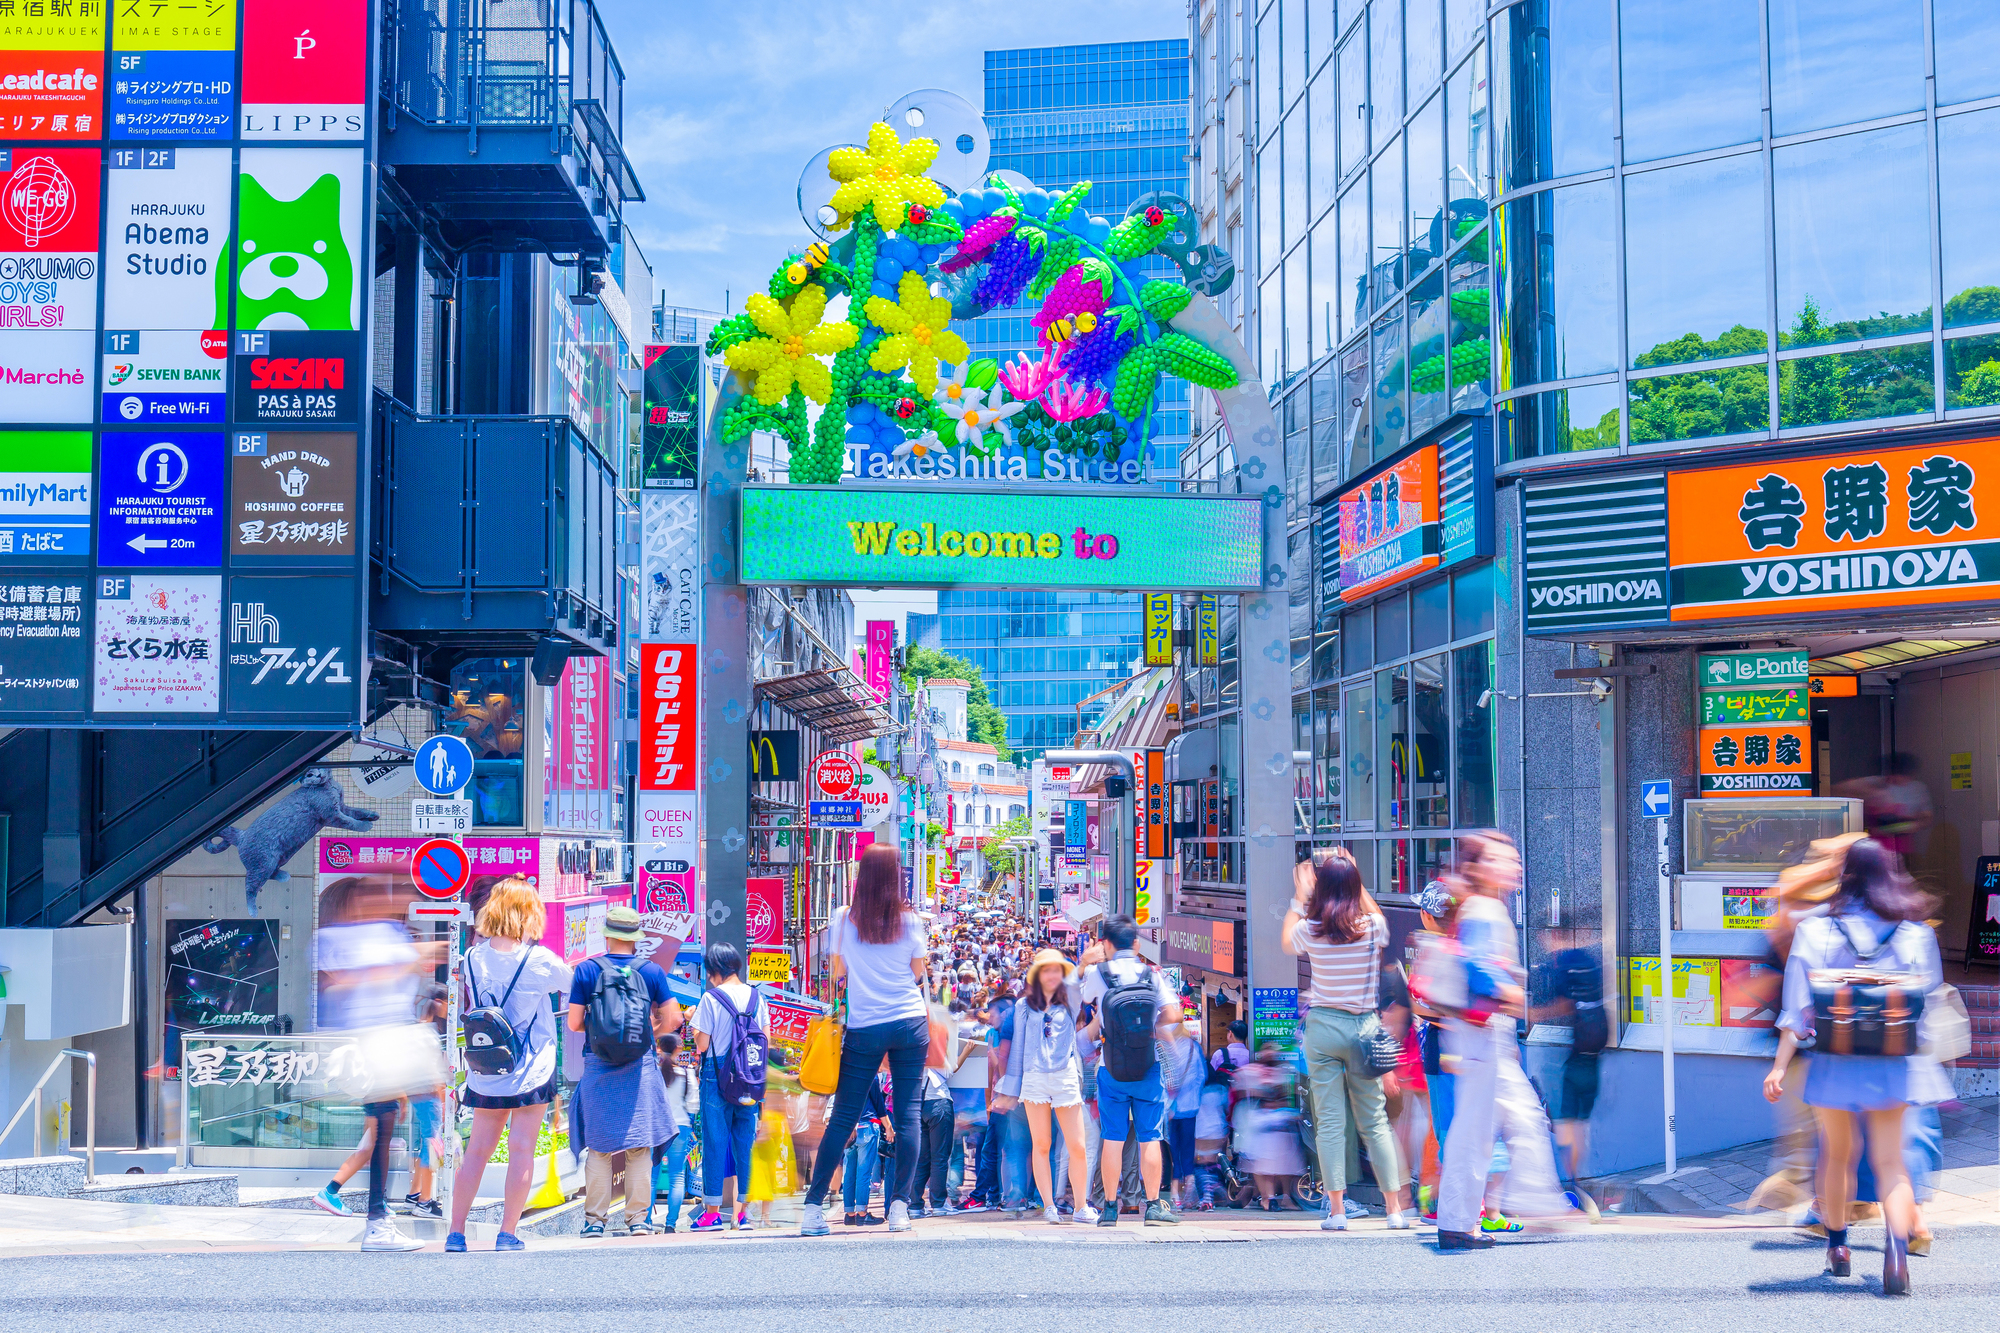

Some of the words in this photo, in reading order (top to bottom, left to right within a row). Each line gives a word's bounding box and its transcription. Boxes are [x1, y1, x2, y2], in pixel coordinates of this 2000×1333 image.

[121, 28, 162, 36] IMAE
[172, 28, 223, 36] STAGE
[120, 57, 141, 70] 5F
[126, 98, 159, 106] Risingpro
[244, 115, 362, 132] LIPPS
[128, 127, 150, 135] Rising
[152, 127, 189, 136] production
[116, 151, 134, 166] 1F
[148, 151, 169, 166] 2F
[131, 204, 206, 216] HARAJUKU
[125, 223, 210, 246] Abema
[127, 254, 208, 276] Studio
[111, 334, 131, 350] 1F
[240, 334, 264, 351] 1F
[645, 347, 658, 358] 3F
[136, 368, 180, 381] SEVEN
[184, 368, 222, 381] BANK
[250, 357, 345, 390] SASAKI
[150, 402, 179, 414] Free
[182, 402, 210, 414] Wi-Fi
[258, 395, 290, 409] PAS
[292, 394, 302, 409] à
[305, 395, 337, 409] PAS
[258, 410, 303, 418] HARAJUKU
[306, 410, 336, 418] SASAKI
[239, 436, 261, 453] BF
[260, 450, 298, 470] HAND
[300, 450, 331, 469] DRIP
[845, 443, 1028, 481] Takeshita
[1042, 448, 1157, 485] Street
[116, 497, 165, 505] HARAJUKU
[166, 497, 207, 505] TOURIST
[245, 502, 297, 512] HOSHINO
[300, 502, 345, 512] COFFEE
[1738, 454, 1978, 553] 吉野家
[109, 507, 176, 516] INFORMATION
[178, 507, 214, 516] CENTER
[125, 517, 140, 525] 原宿
[239, 519, 350, 547] 星乃珈琲
[848, 521, 1062, 558] Welcome
[1071, 526, 1119, 560] to
[21, 532, 64, 551] たばこ
[170, 538, 196, 549] 20m
[1740, 548, 1979, 597] YOSHINOYA
[103, 579, 125, 597] BF
[679, 568, 692, 597] CAT
[1530, 578, 1662, 609] YOSHINOYA
[679, 599, 692, 634] CAFE
[16, 625, 60, 637] Evacuation
[61, 625, 81, 637] Area
[107, 637, 209, 661] さくら水産
[231, 654, 266, 666] はらじゅく
[251, 646, 352, 686] アッシュ
[1149, 655, 1171, 664] 3F
[1756, 657, 1809, 676] Ponte
[123, 676, 155, 684] Sakura
[157, 676, 188, 684] Suisan
[112, 684, 142, 693] Japanese
[1726, 694, 1799, 710] ビリヤード
[654, 650, 683, 785] OSドラッグ
[1739, 706, 1787, 721] ダーツ
[1711, 733, 1802, 768] 吉野家
[819, 769, 852, 784] 消火栓
[1712, 774, 1803, 789] YOSHINOYA
[415, 804, 469, 816] 自転車を除く
[644, 809, 692, 822] QUEEN
[418, 817, 430, 829] 11
[453, 817, 465, 829] 18
[652, 825, 683, 838] EYES
[750, 955, 789, 968] ハッピーワン
[1632, 959, 1702, 973] コインッカー
[749, 970, 773, 980] HAPPY
[774, 972, 788, 981] ONE
